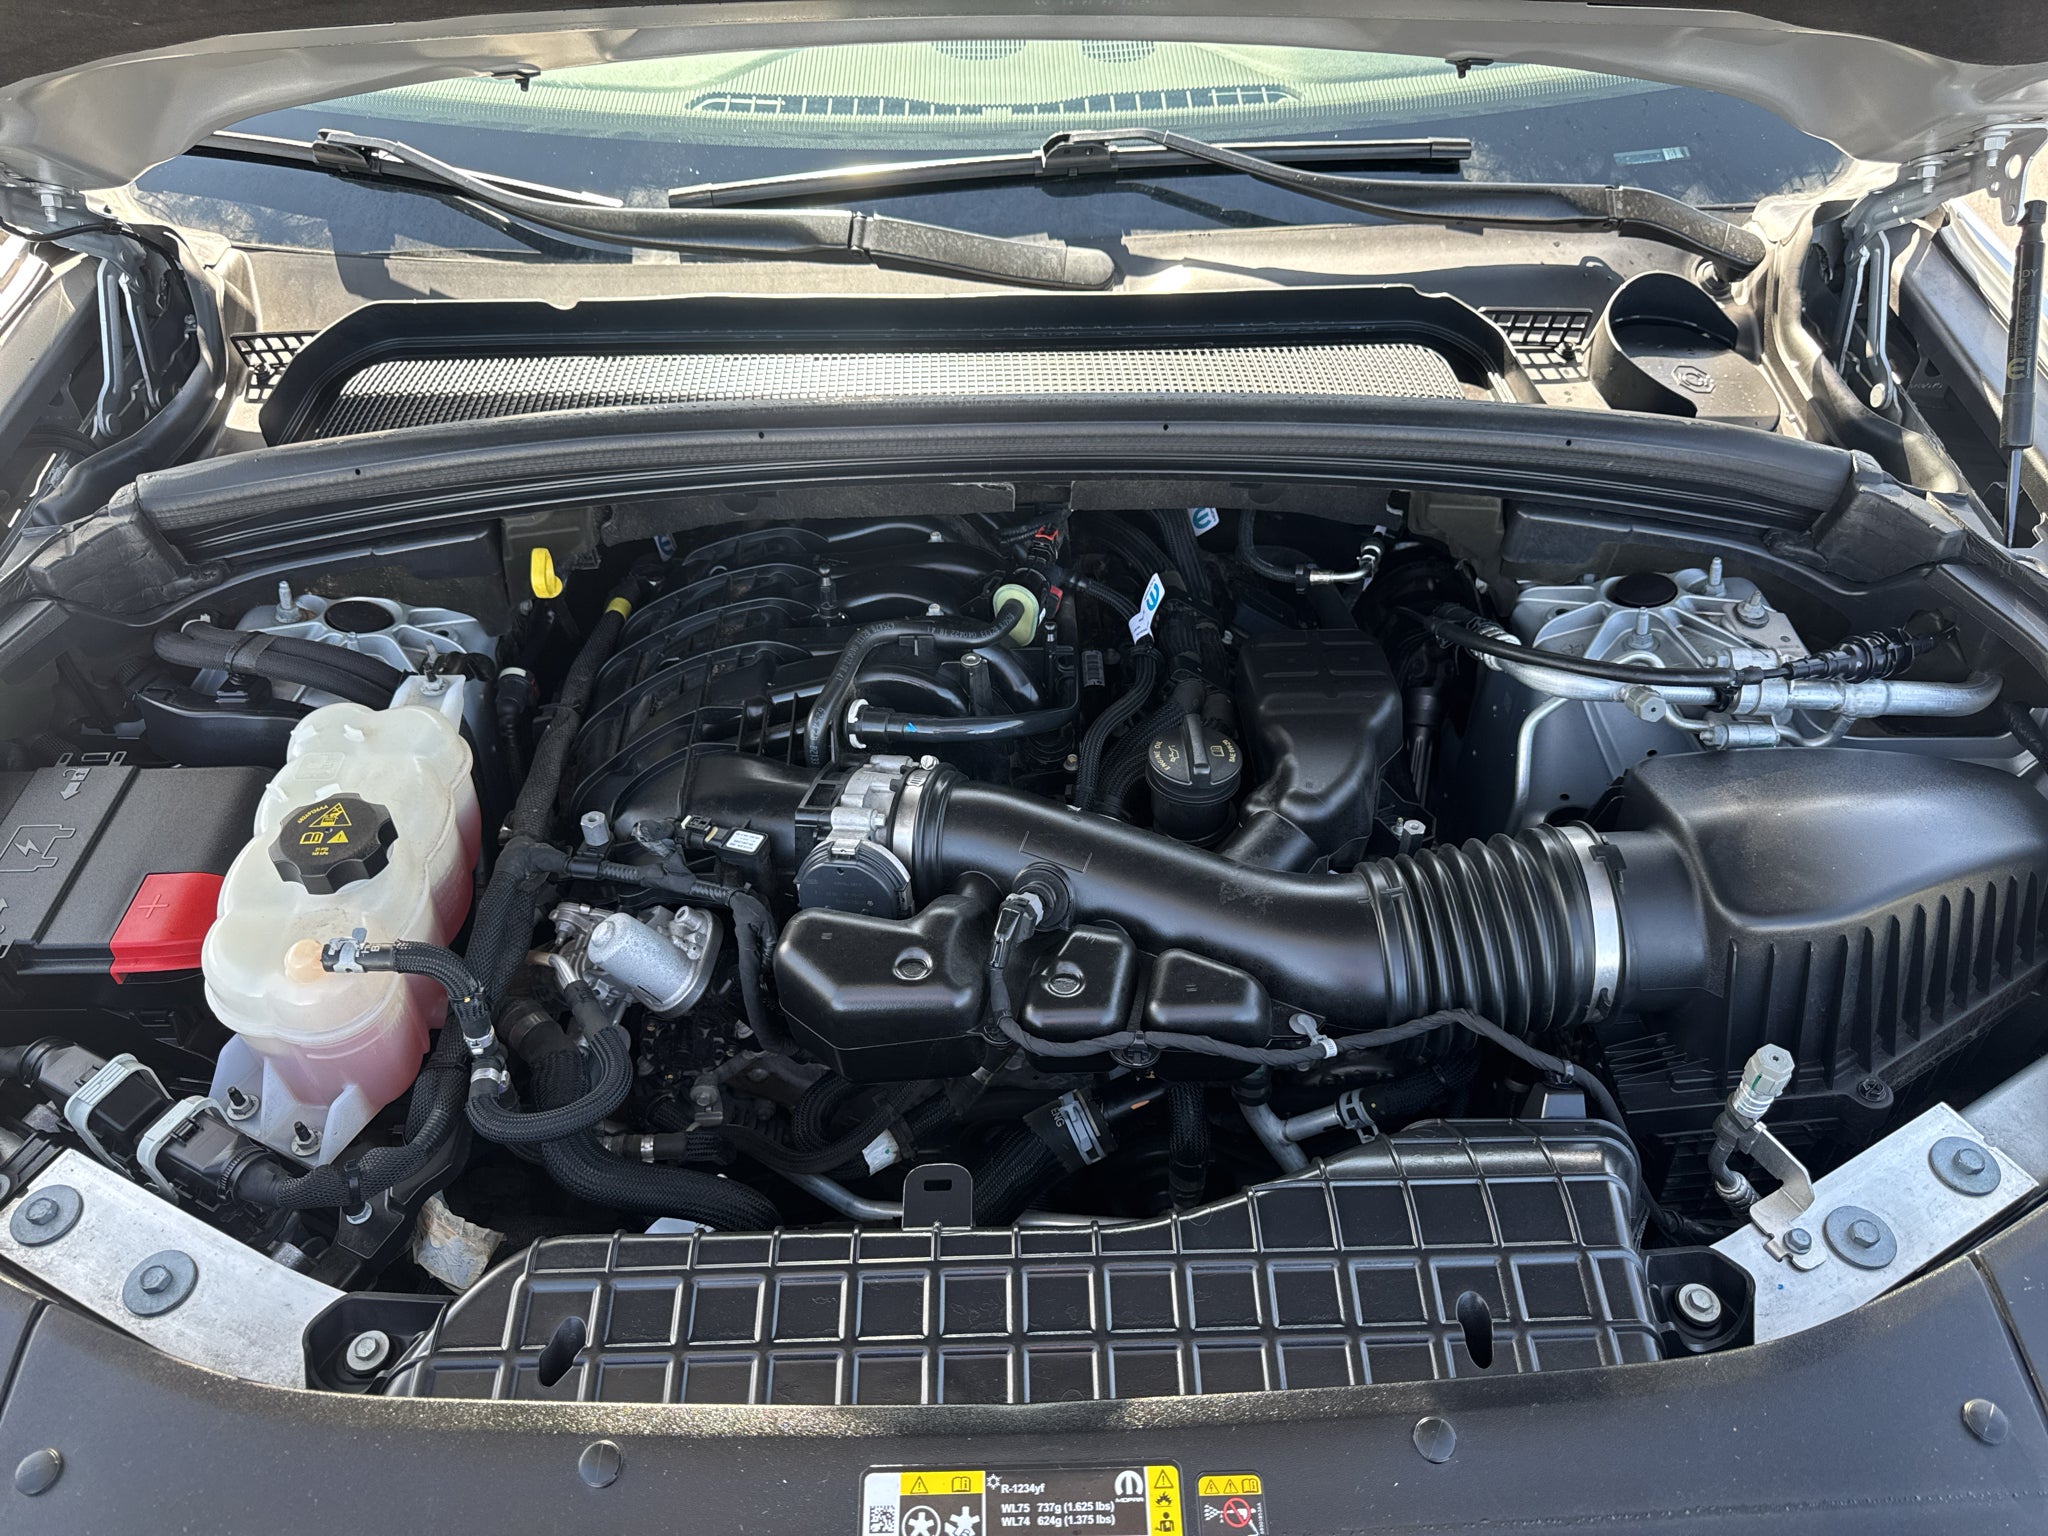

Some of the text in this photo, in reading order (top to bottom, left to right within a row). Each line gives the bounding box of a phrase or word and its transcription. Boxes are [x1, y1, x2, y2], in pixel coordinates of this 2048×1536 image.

[1051, 1108, 1065, 1127] ENG
[1001, 1483, 1046, 1495] R-1234yf
[1001, 1501, 1115, 1514] WL75 737g (1.625 lbs)
[1001, 1514, 1116, 1527] WL74 624g (1.375 lbs)
